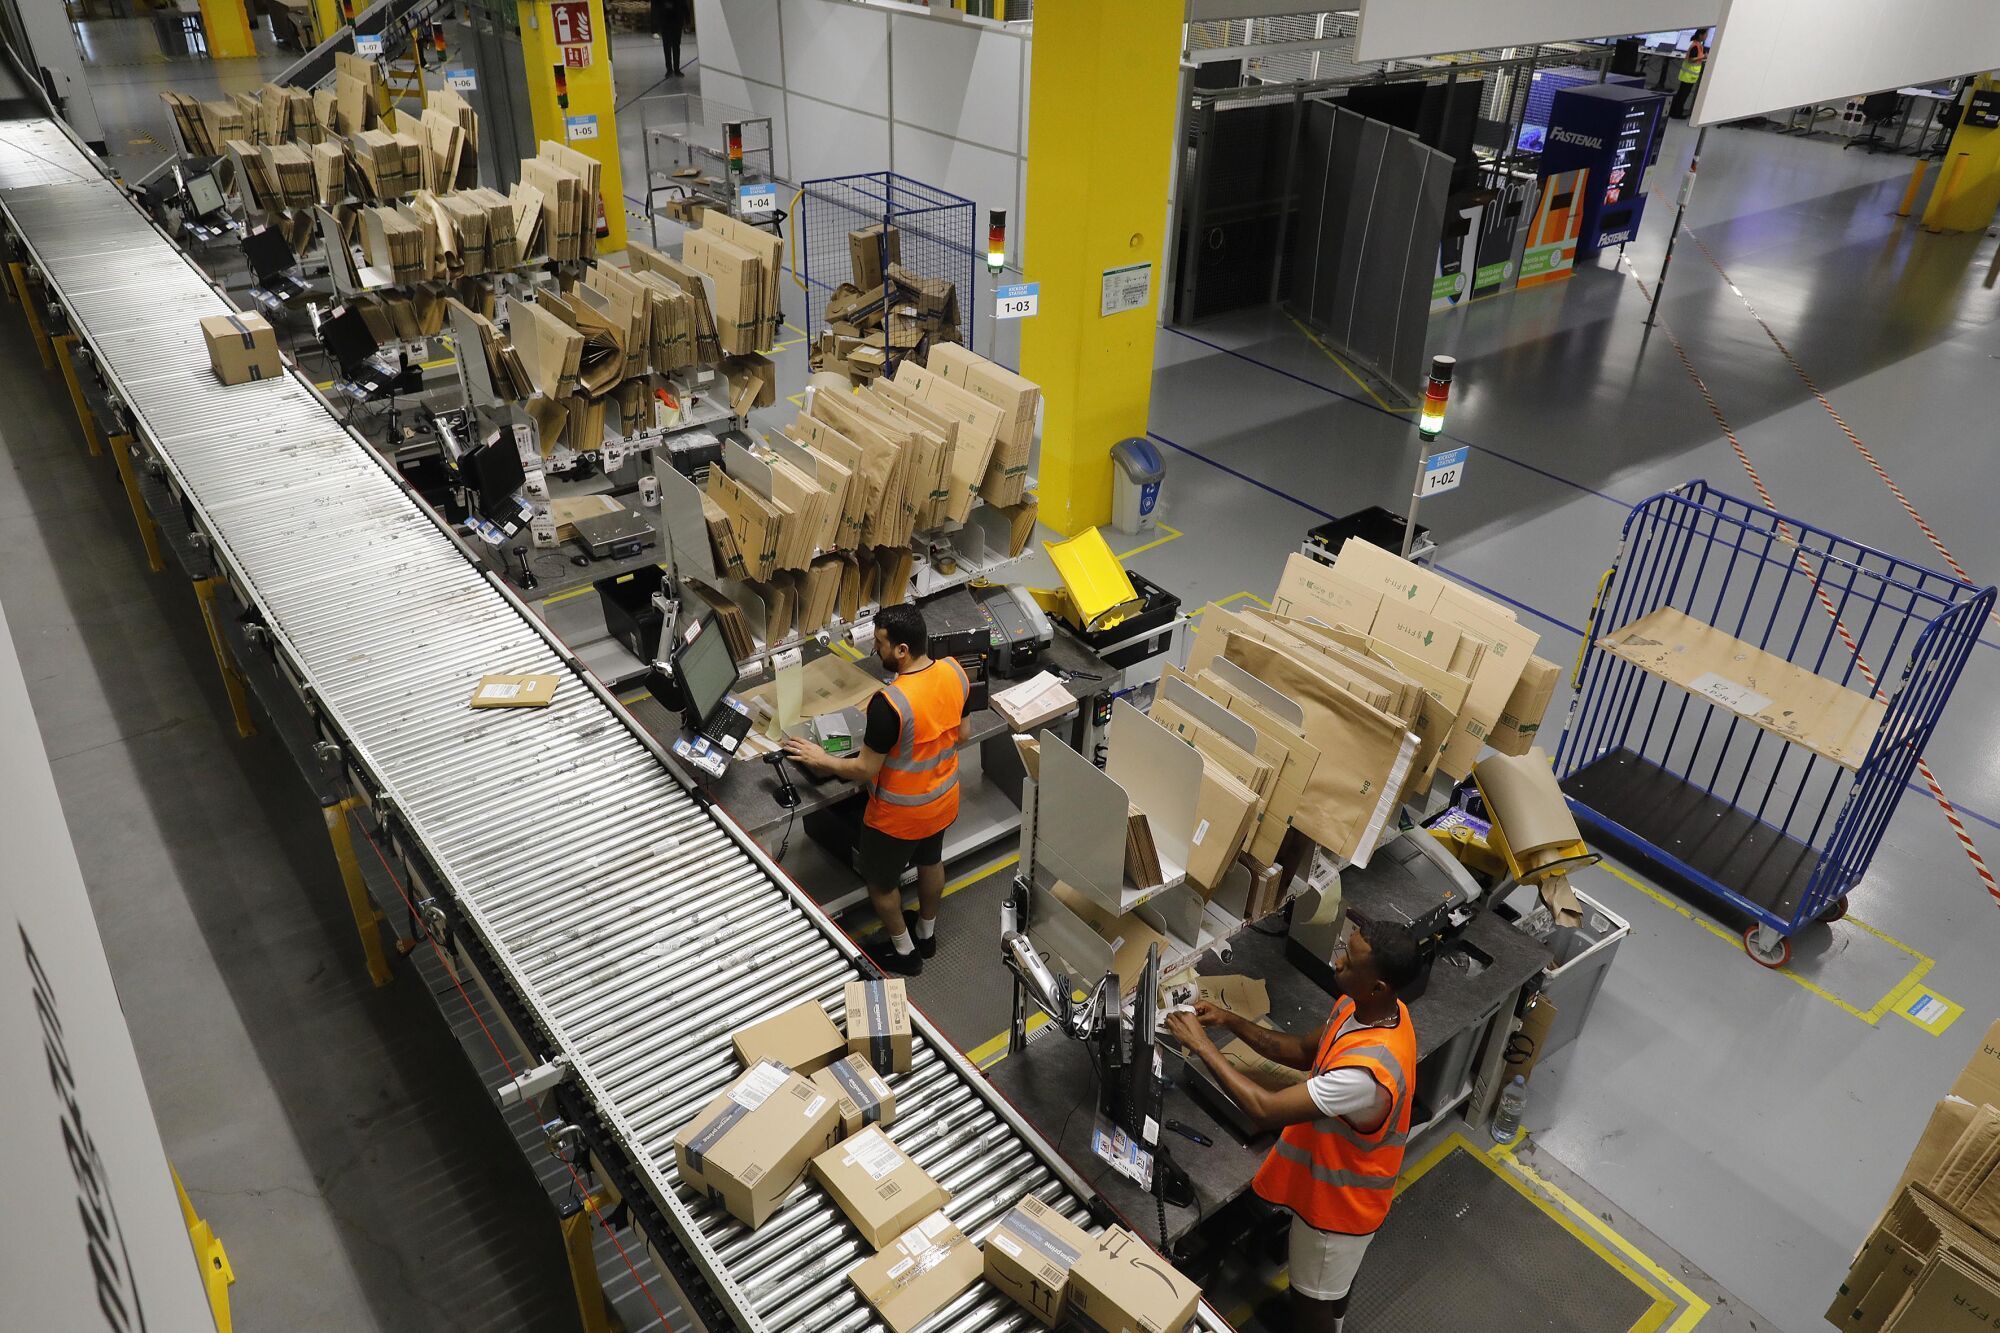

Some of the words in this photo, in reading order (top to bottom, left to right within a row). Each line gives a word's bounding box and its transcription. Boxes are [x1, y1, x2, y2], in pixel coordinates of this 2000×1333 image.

[574, 126, 593, 135] 1-05
[1549, 126, 1603, 150] FASTENAL
[747, 198, 769, 208] 1-04
[1597, 230, 1631, 248] FASTENAL
[1008, 285, 1028, 293] KICKOUT
[1005, 301, 1030, 313] 1-03
[1437, 457, 1455, 467] STATION
[1438, 452, 1457, 462] KICKOUT
[1431, 470, 1455, 488] 1-02
[1359, 779, 1372, 796] BP4
[1952, 1293, 1989, 1321] F7-R
